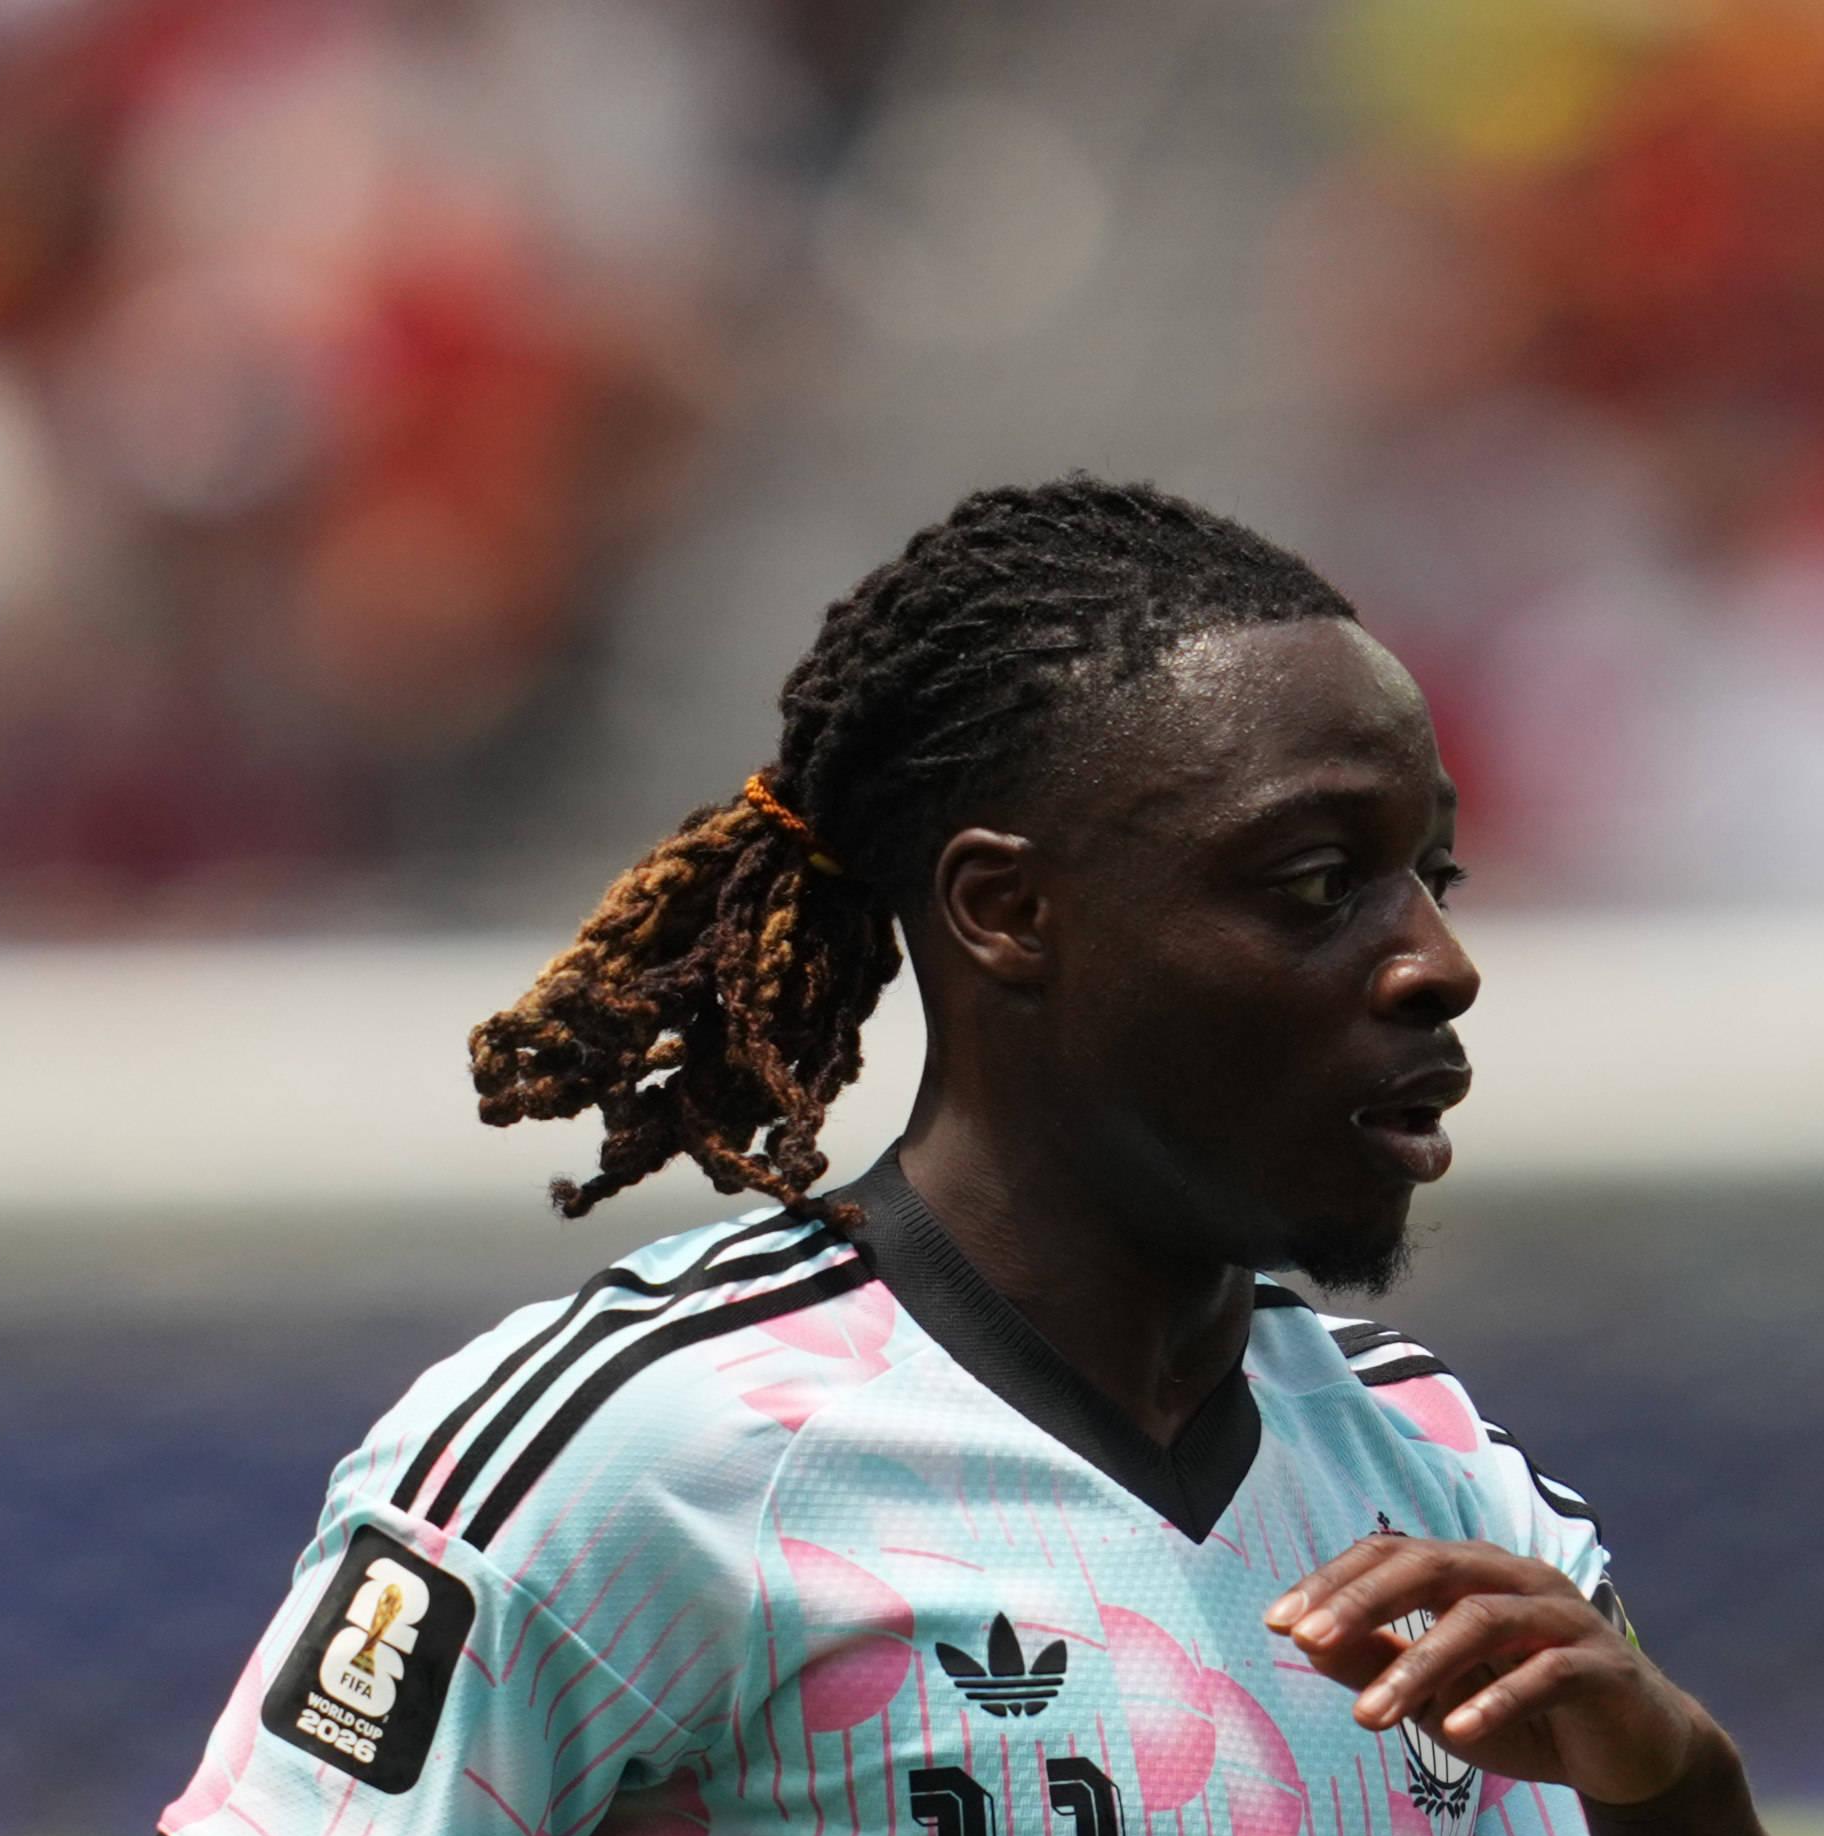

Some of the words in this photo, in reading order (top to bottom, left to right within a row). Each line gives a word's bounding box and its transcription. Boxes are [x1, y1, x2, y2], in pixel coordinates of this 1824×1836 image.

[340, 1671, 373, 1700] FIFA
[296, 1709, 377, 1764] 2026
[307, 1692, 355, 1726] WORLD
[355, 1718, 383, 1740] CUP
